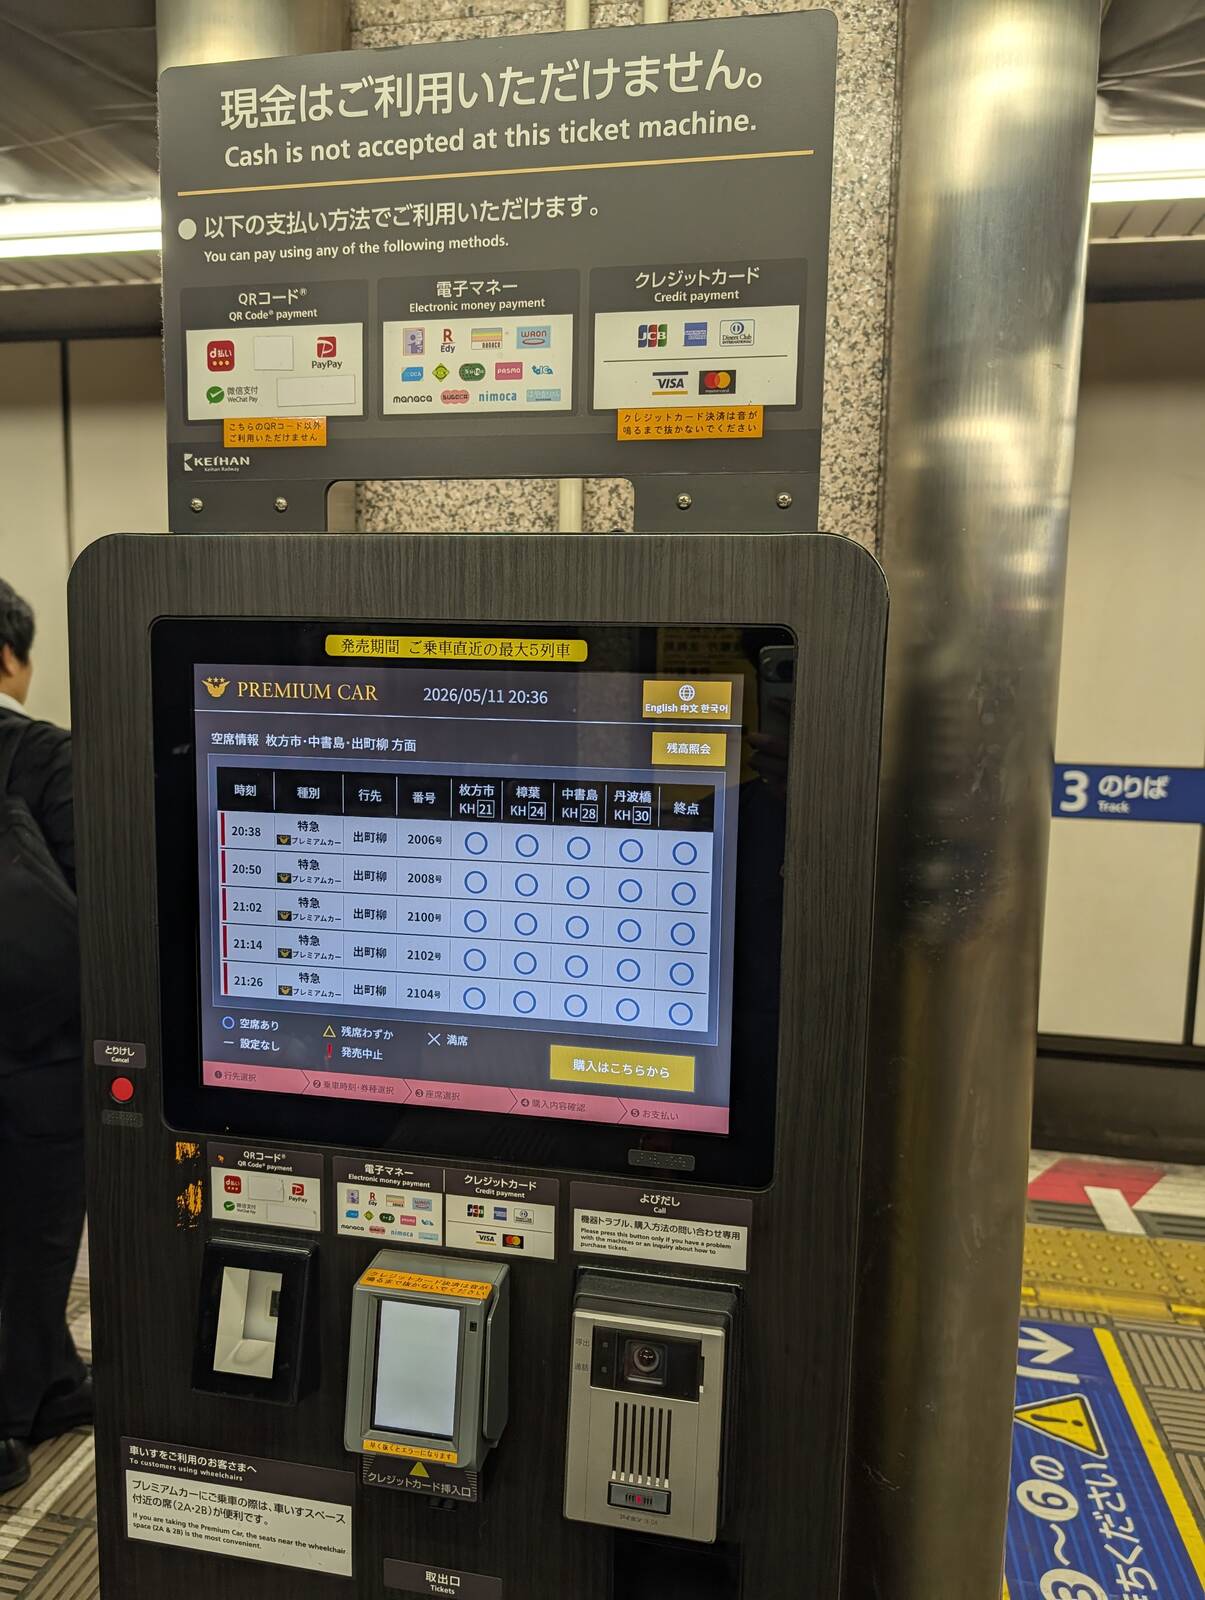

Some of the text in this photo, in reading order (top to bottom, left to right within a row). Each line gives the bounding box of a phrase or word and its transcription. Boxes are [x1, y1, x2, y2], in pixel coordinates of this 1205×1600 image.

[220, 48, 762, 131] 現金はご利用いただけません。
[224, 109, 757, 168] Cash is not accepted at this ticket machine.
[203, 194, 599, 240] 以下の支払い方法でご利用いただけます。
[203, 233, 509, 264] You can pay using any of the following methods.
[634, 266, 760, 289] クレジットカード
[436, 279, 518, 298] 電子マネー
[654, 289, 740, 304] Credit payment
[409, 297, 546, 313] Electronic money payment
[228, 311, 243, 323] QR
[276, 307, 317, 321] payment
[440, 343, 456, 354] Edy
[311, 360, 343, 370] PayPay
[655, 378, 685, 389] VISA
[393, 395, 433, 404] manaca
[479, 390, 517, 402] nimoca
[623, 410, 758, 423] クレジットカード決済は音が
[229, 433, 318, 443] ご利用いただけません
[194, 455, 250, 466] KEIHAN
[341, 639, 571, 658] 発売期間 ご乗車直近の最大5列車
[237, 681, 378, 701] PREMIUM CAR
[423, 687, 548, 705] 2026/05/11 20:36
[645, 703, 678, 714] English
[680, 703, 699, 713] 中文
[210, 732, 259, 747] 空席情報
[391, 738, 417, 753] 方面
[666, 742, 711, 755] 残高照会
[234, 783, 257, 797] 時刻
[296, 786, 320, 799] 種別
[357, 788, 382, 802] 行先
[458, 783, 495, 797] 枚方市
[561, 787, 598, 801] 中書島
[613, 789, 652, 804] 丹波橋
[1059, 770, 1171, 812] 3 のりば
[412, 791, 436, 804] 番号
[459, 802, 493, 815] KH 21
[510, 805, 545, 817] KH 24
[561, 807, 597, 819] KH 28
[673, 801, 700, 816] 終点
[1097, 799, 1130, 815] Track
[614, 809, 650, 822] KH 30
[231, 825, 261, 837] 20:38
[297, 820, 320, 832] 特急
[291, 836, 342, 846] プレミアムカー
[353, 831, 387, 844] 出町柳
[232, 863, 262, 875] 20:50
[297, 858, 320, 871] 特急
[291, 874, 342, 884] プレミアムカー
[353, 869, 387, 882] 出町柳
[232, 901, 262, 913] 21:02
[298, 897, 320, 909] 特急
[292, 912, 342, 923] プレミアムカー
[353, 907, 387, 920] 出町柳
[233, 938, 263, 950] 21:14
[298, 934, 321, 946] 特急
[292, 950, 342, 960] プレミアムカー
[353, 945, 387, 958] 出町柳
[234, 975, 263, 987] 21:26
[298, 972, 321, 984] 特急
[293, 988, 342, 998] プレミアムカー
[353, 983, 387, 996] 出町柳
[239, 1018, 280, 1031] 空席あり
[341, 1025, 394, 1041] 残席わずか
[446, 1033, 469, 1046] 満席
[105, 1045, 136, 1057] とりけし
[239, 1038, 280, 1052] 設定なし
[340, 1046, 383, 1060] 発売中止
[111, 1056, 130, 1064] Cancel
[572, 1057, 670, 1079] 購入はこちらから
[642, 1109, 679, 1121] お支払い
[266, 1163, 293, 1172] payment
[364, 1163, 414, 1176] 電子マネー
[348, 1173, 431, 1189] Electronic money payment
[464, 1174, 537, 1191] クレジットカード
[475, 1187, 525, 1199] Credit payment
[639, 1193, 681, 1207] よびだし
[653, 1206, 667, 1214] Call
[580, 1227, 732, 1250] Please press button problem
[606, 1237, 693, 1252] machines about
[580, 1241, 607, 1250] purchase
[129, 1445, 257, 1473] 車いすをご利用のお客さまへ
[129, 1457, 244, 1481] To customers using wheelchairs
[367, 1472, 471, 1497] クレジットカード挿入口
[131, 1479, 347, 1525] プレミアムカーにご乗車の際は、車いすスペース
[132, 1522, 262, 1549] space most convenient.
[165, 1517, 347, 1555] taking Premium Car, seats wheelchair
[425, 1570, 461, 1587] 取出口
[430, 1584, 455, 1595] Tickets
